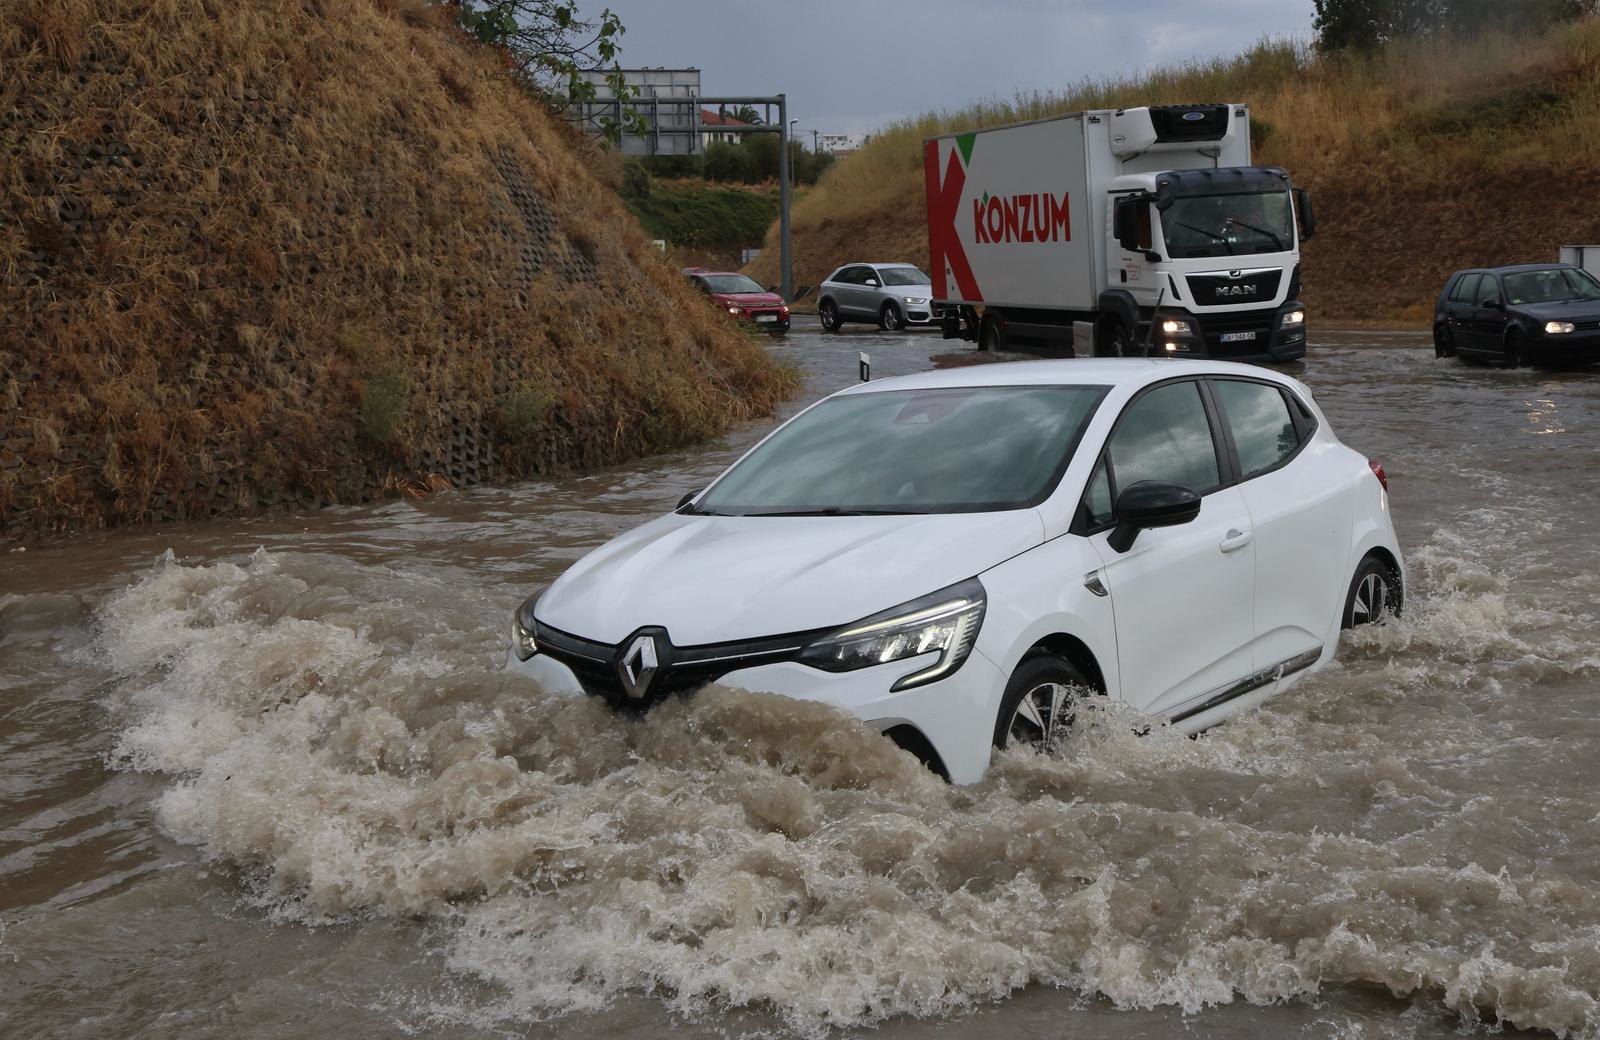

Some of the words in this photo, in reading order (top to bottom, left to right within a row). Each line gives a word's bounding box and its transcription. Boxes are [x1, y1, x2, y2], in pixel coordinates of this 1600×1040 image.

[924, 138, 984, 302] K
[974, 191, 1071, 244] KONZUM
[1215, 285, 1257, 297] MAN
